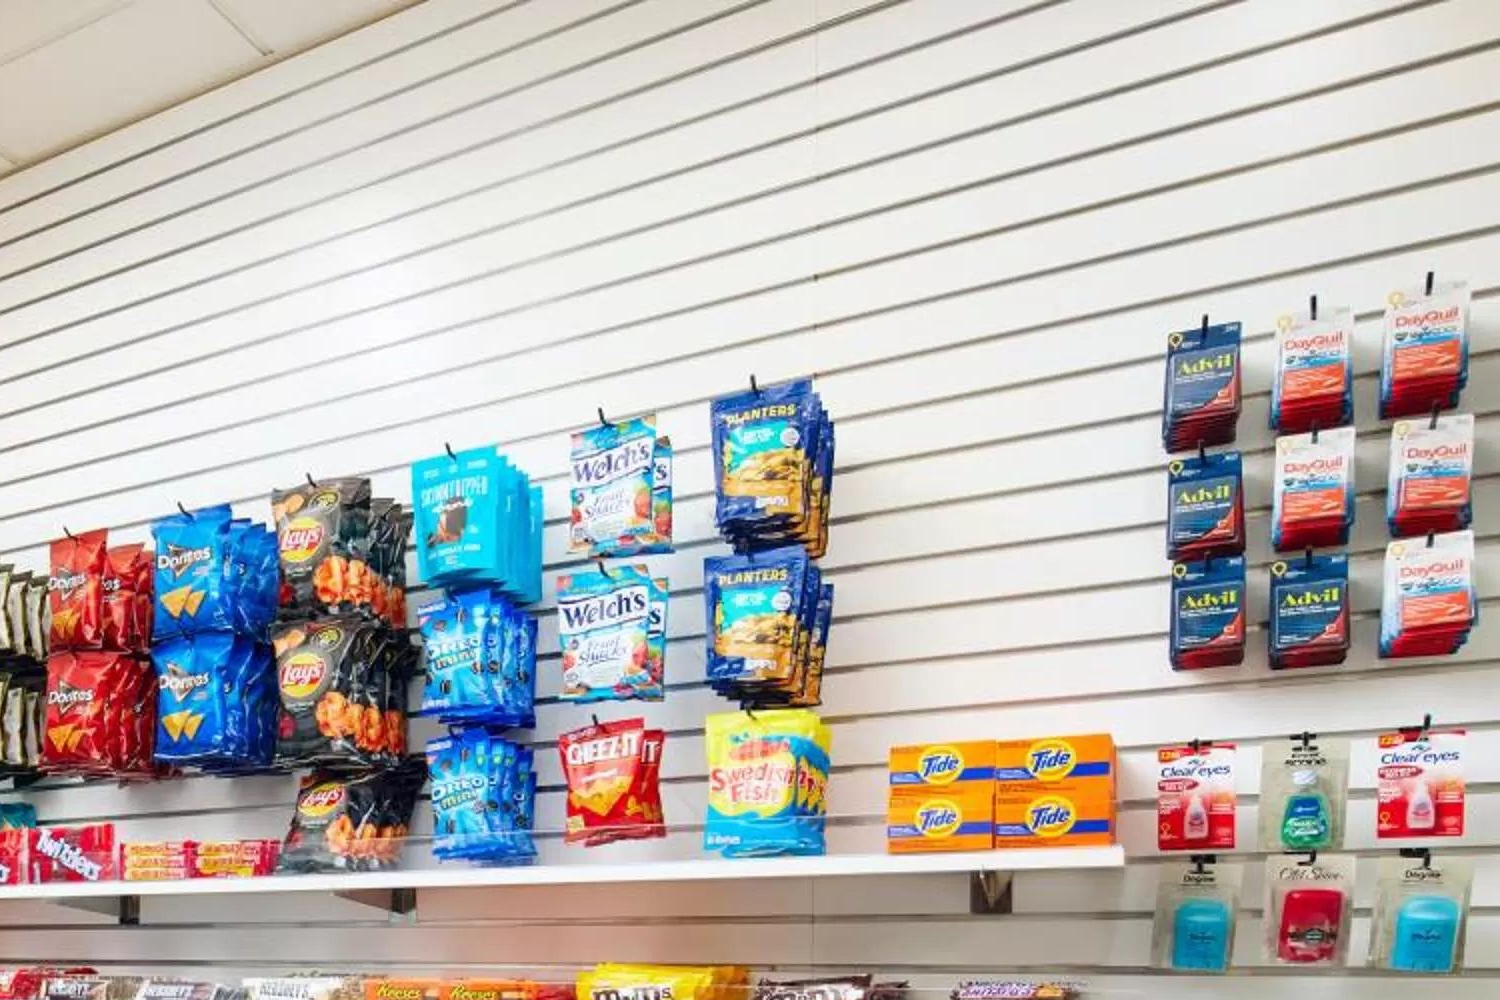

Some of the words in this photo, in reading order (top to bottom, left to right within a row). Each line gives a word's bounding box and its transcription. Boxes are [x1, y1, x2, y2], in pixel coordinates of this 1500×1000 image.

[1395, 306, 1460, 328] DayQuil
[1284, 331, 1343, 351] DayQuil
[1178, 353, 1233, 376] Advil
[725, 403, 797, 427] PLANTERS
[1407, 443, 1467, 461] DayQuil
[573, 442, 650, 483] Welch's
[1283, 456, 1343, 475] DayQuil
[1177, 485, 1231, 505] Advil
[157, 546, 212, 570] Doritos
[718, 568, 788, 585] PLANTERS
[1400, 559, 1464, 578] DayQuil
[50, 573, 87, 590] Doritos
[1181, 590, 1237, 609] Advil
[1281, 587, 1340, 607] Advil
[563, 591, 646, 629] Welch's
[158, 671, 210, 689] Doritos
[48, 688, 94, 704] Doritos
[921, 755, 959, 777] Tide
[1031, 749, 1071, 773] Tide
[1380, 753, 1418, 765] Clear
[1423, 751, 1460, 766] eyes
[711, 763, 797, 791] Swedish
[1160, 767, 1197, 778] Clear
[1199, 765, 1231, 779] eyes
[431, 775, 485, 800] OREO
[730, 782, 782, 803] Fish
[919, 808, 957, 831] Tide
[1030, 805, 1071, 829] Tide
